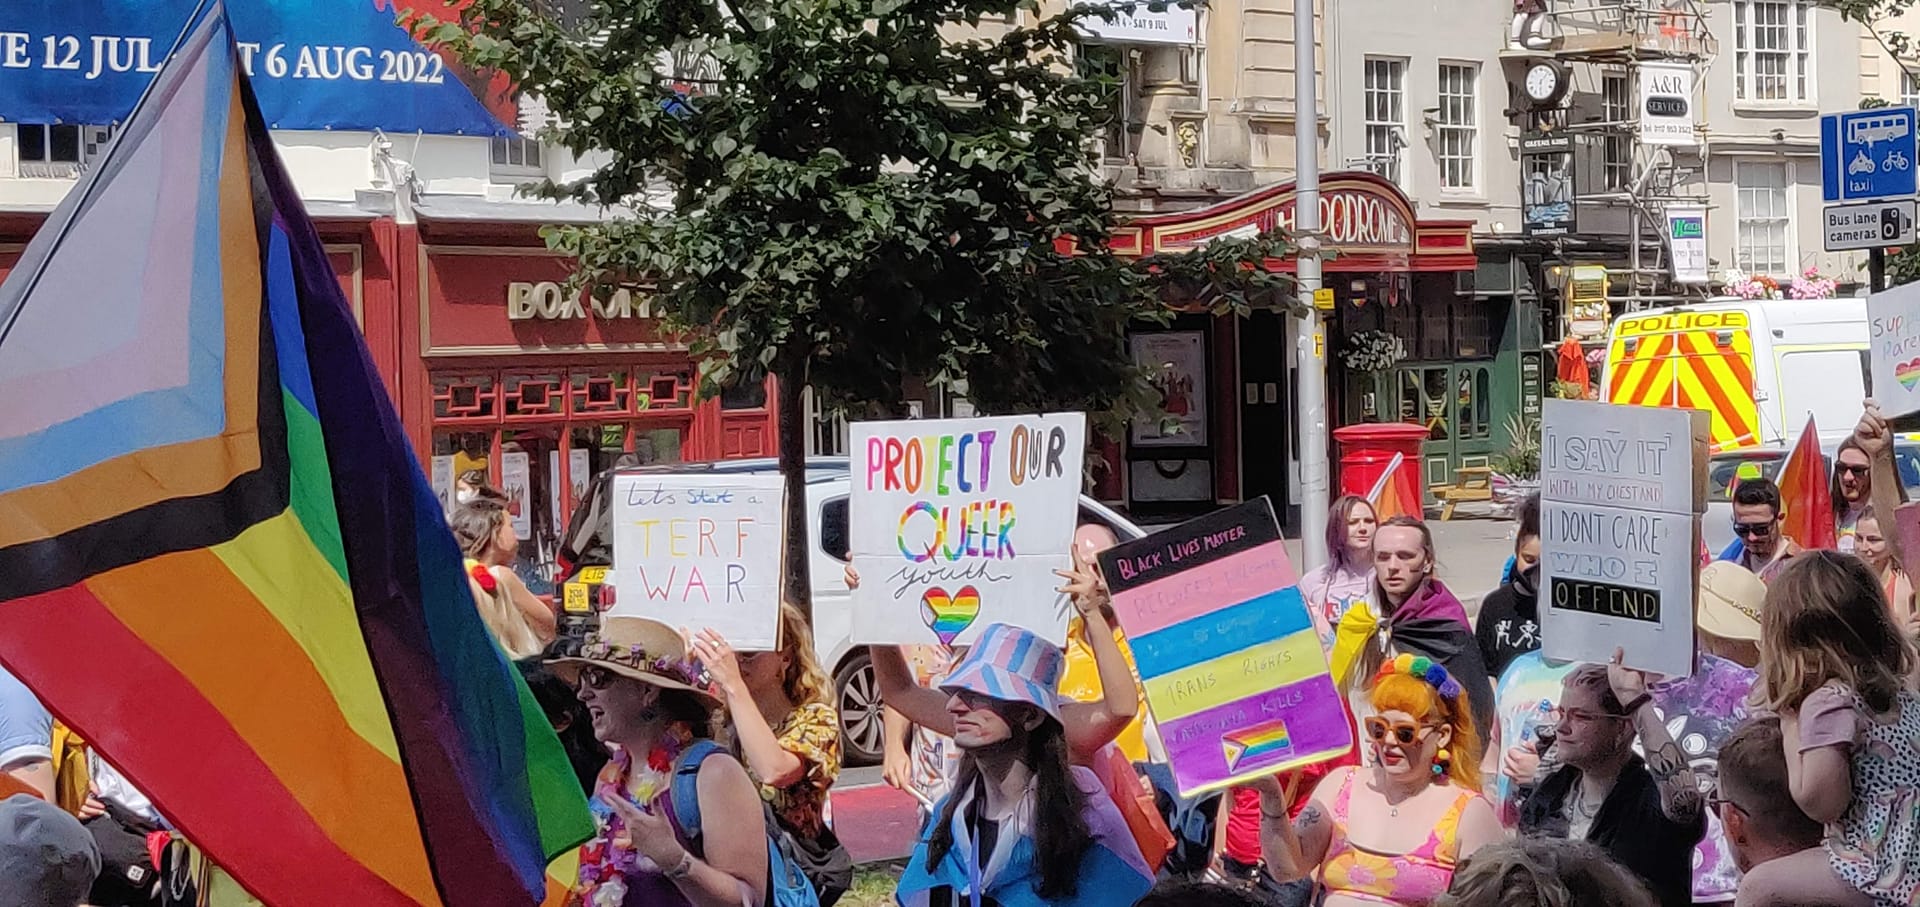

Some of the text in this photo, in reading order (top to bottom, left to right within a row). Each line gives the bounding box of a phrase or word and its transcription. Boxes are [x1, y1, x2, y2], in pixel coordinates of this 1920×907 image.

[1133, 18, 1147, 28] SAT
[1148, 19, 1153, 29] 9
[1154, 20, 1168, 30] JUL
[42, 35, 81, 70] 12
[85, 35, 162, 80] JUL
[265, 43, 287, 78] 6
[292, 45, 375, 80] AUG
[380, 50, 445, 84] 2022
[1649, 75, 1683, 94] A&R
[1647, 101, 1687, 113] SERVICES
[1849, 178, 1870, 192] taxi
[1829, 211, 1877, 227] Bus lane
[1830, 229, 1877, 242] cameras
[1620, 312, 1743, 336] POLICE
[866, 423, 1067, 496] PROTECT OUR
[1549, 434, 1668, 476] I SAY IT
[1548, 479, 1578, 497] WITH
[1587, 482, 1604, 500] MY
[634, 518, 755, 558] TERF
[896, 499, 1016, 564] QUEER
[1561, 509, 1606, 545] DONT
[1612, 515, 1663, 555] CARE
[1117, 525, 1247, 580] BLACK LIVES MATTER
[1550, 551, 1658, 586] WHO I
[639, 564, 746, 604] WAR
[886, 559, 1013, 600] youth
[1555, 582, 1657, 618] OFFEND
[1166, 649, 1293, 706] TRANS RIGHTS
[1260, 690, 1305, 714] KILLS
